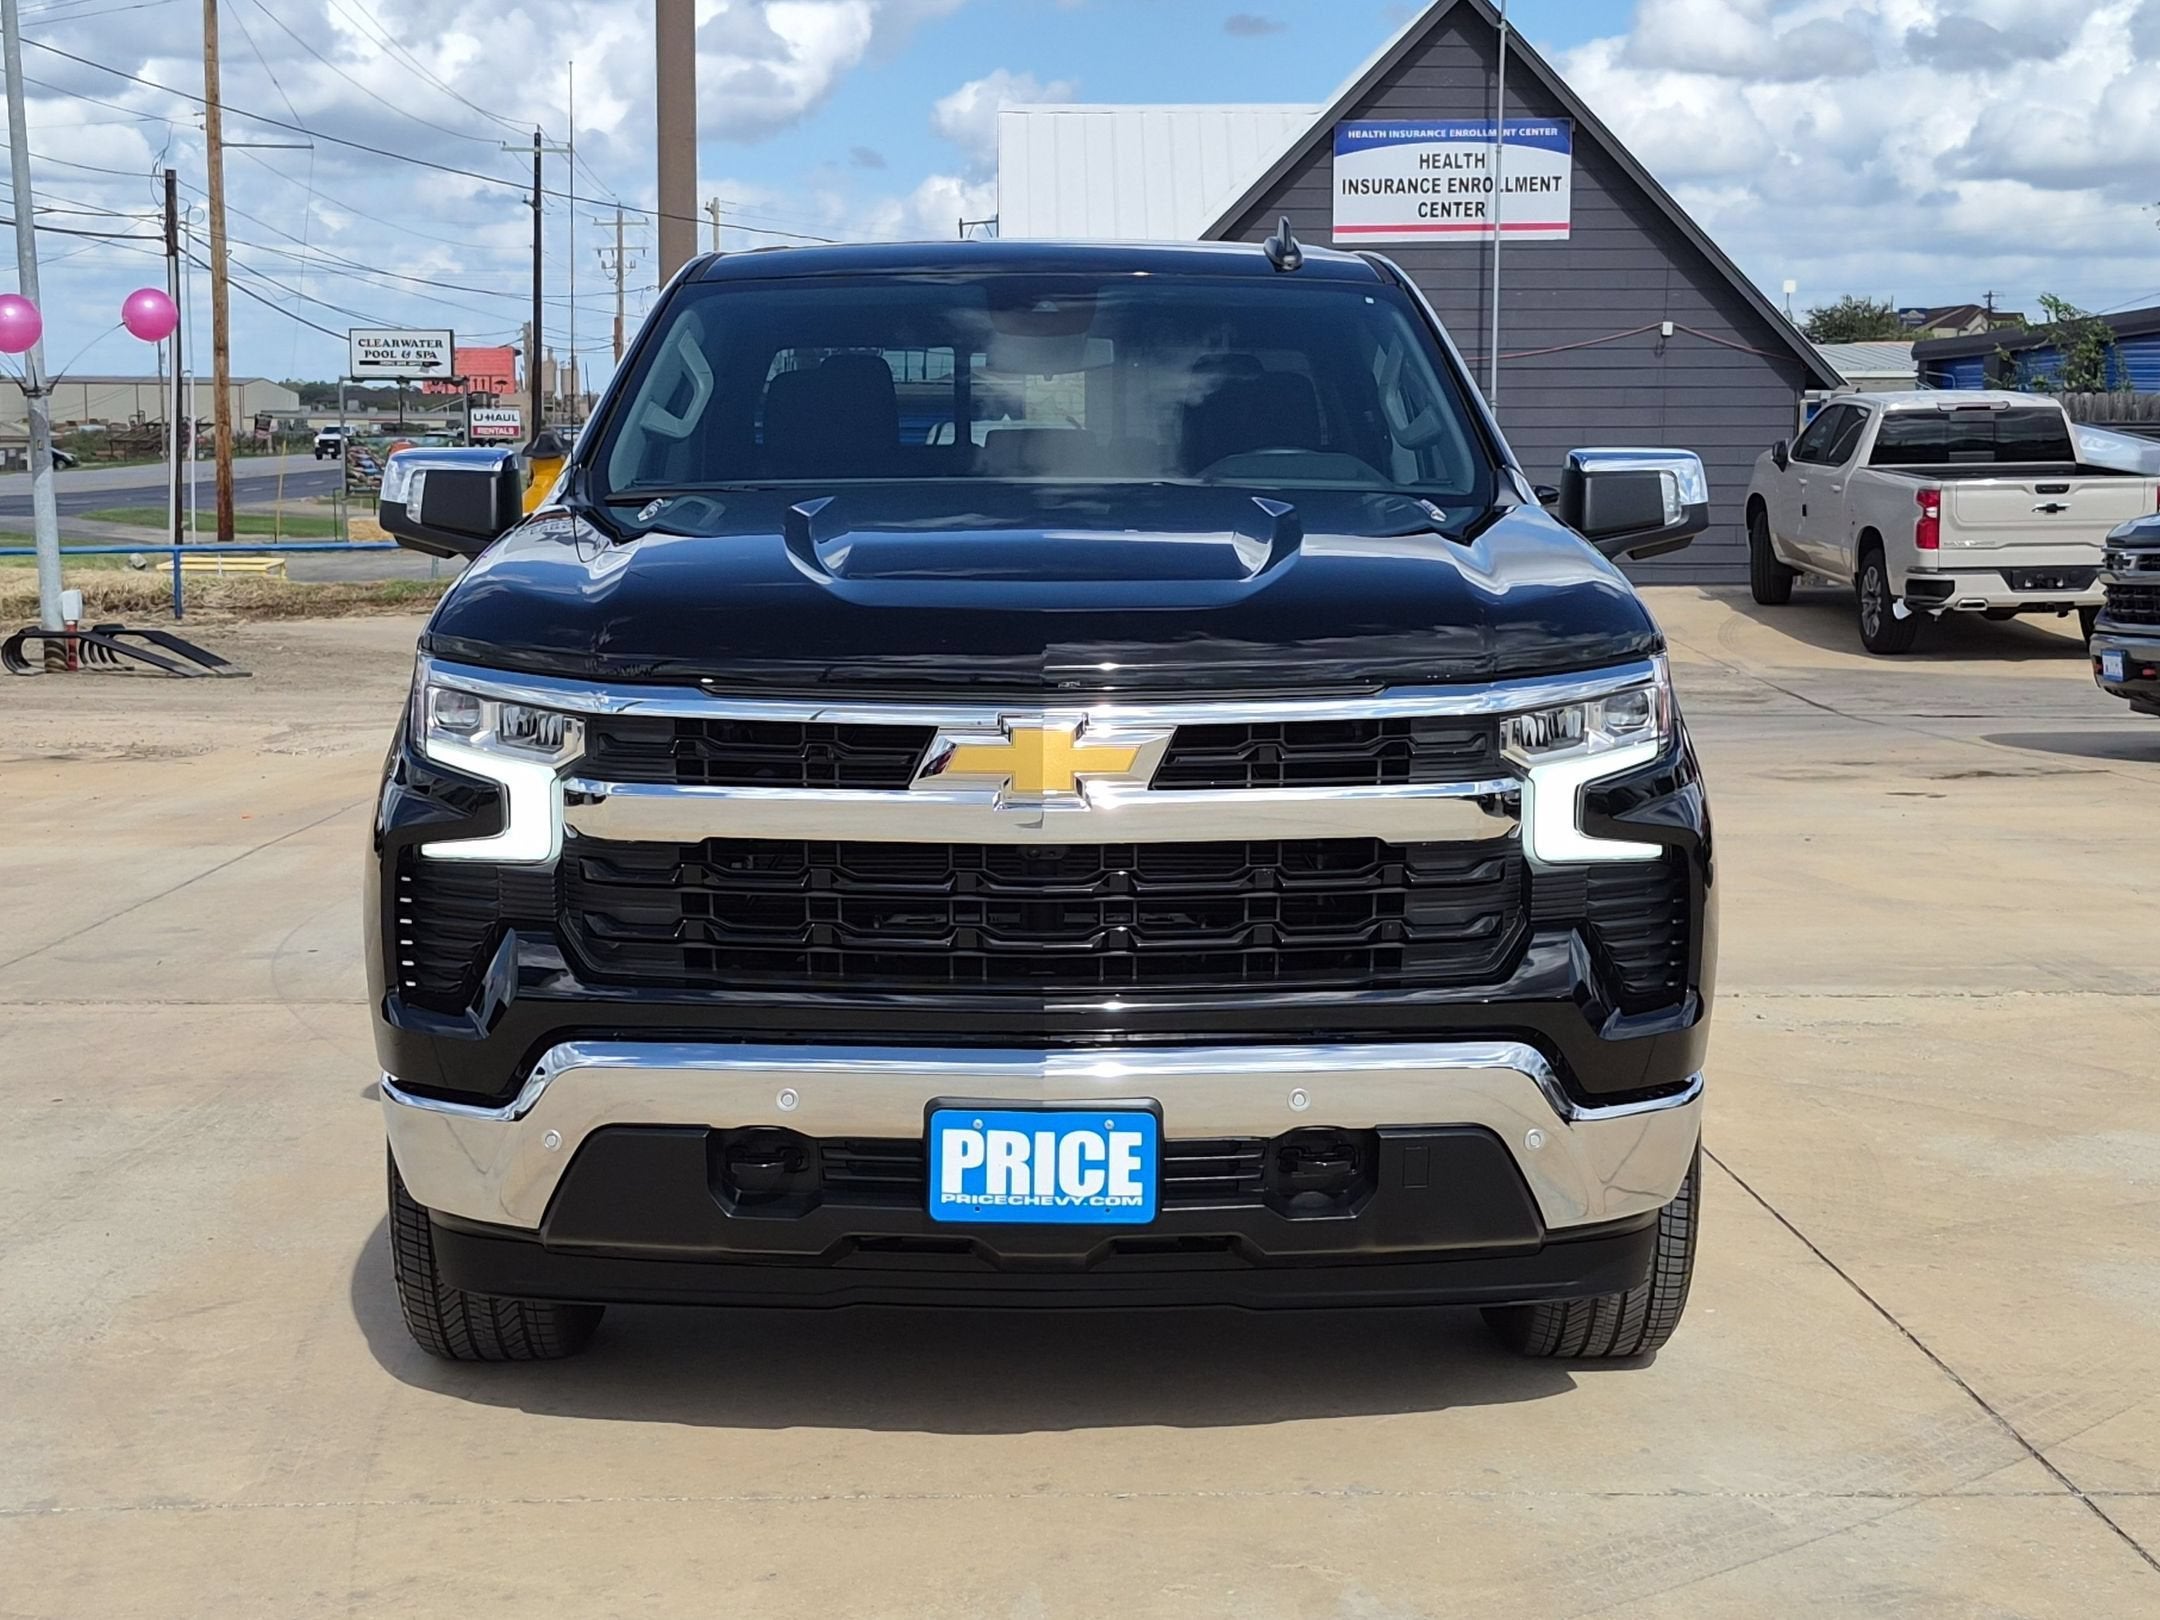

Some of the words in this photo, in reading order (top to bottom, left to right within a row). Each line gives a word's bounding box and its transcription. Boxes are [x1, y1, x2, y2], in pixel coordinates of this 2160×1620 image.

[1348, 130, 1387, 139] HEALTH
[1389, 129, 1446, 138] INSURANCE
[1449, 128, 1516, 137] ENROLLMNT
[1519, 128, 1558, 136] CENTER
[1419, 153, 1485, 169] HEALTH
[1342, 178, 1441, 195] INSURANCE
[1418, 202, 1485, 218] CENTER
[358, 338, 443, 349] CLEARWATER
[364, 350, 397, 359] POOL
[401, 350, 411, 359] &
[416, 350, 437, 359] SPA
[477, 427, 515, 436] RENTALS
[941, 1128, 1144, 1198] PRICE
[941, 1194, 1144, 1206] PRICECHEVY.COM
